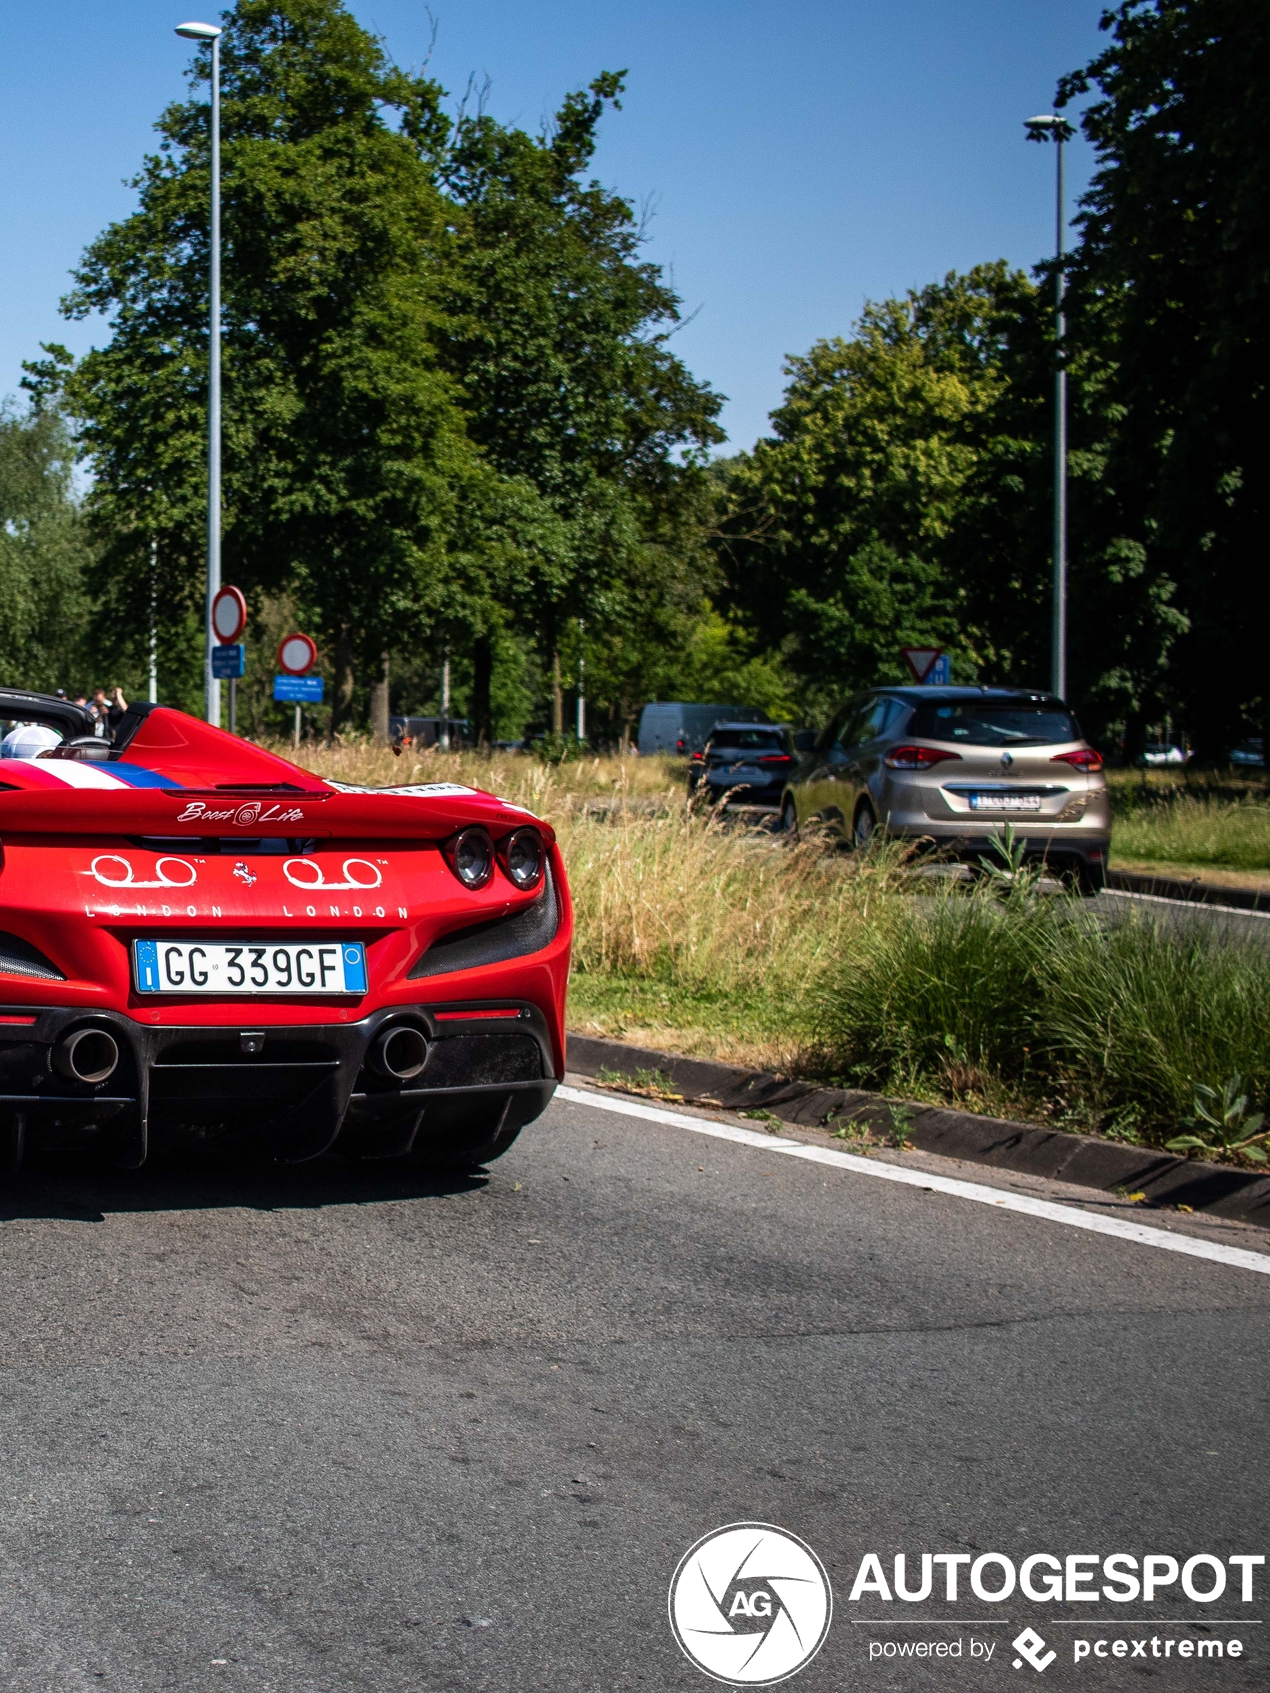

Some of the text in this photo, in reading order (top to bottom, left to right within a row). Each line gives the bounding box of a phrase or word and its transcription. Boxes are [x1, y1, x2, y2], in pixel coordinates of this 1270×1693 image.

[177, 802, 304, 822] Boost Life
[85, 904, 222, 918] LONDON
[283, 905, 408, 919] LONDON
[165, 947, 208, 986] GG
[225, 947, 337, 988] 339GF
